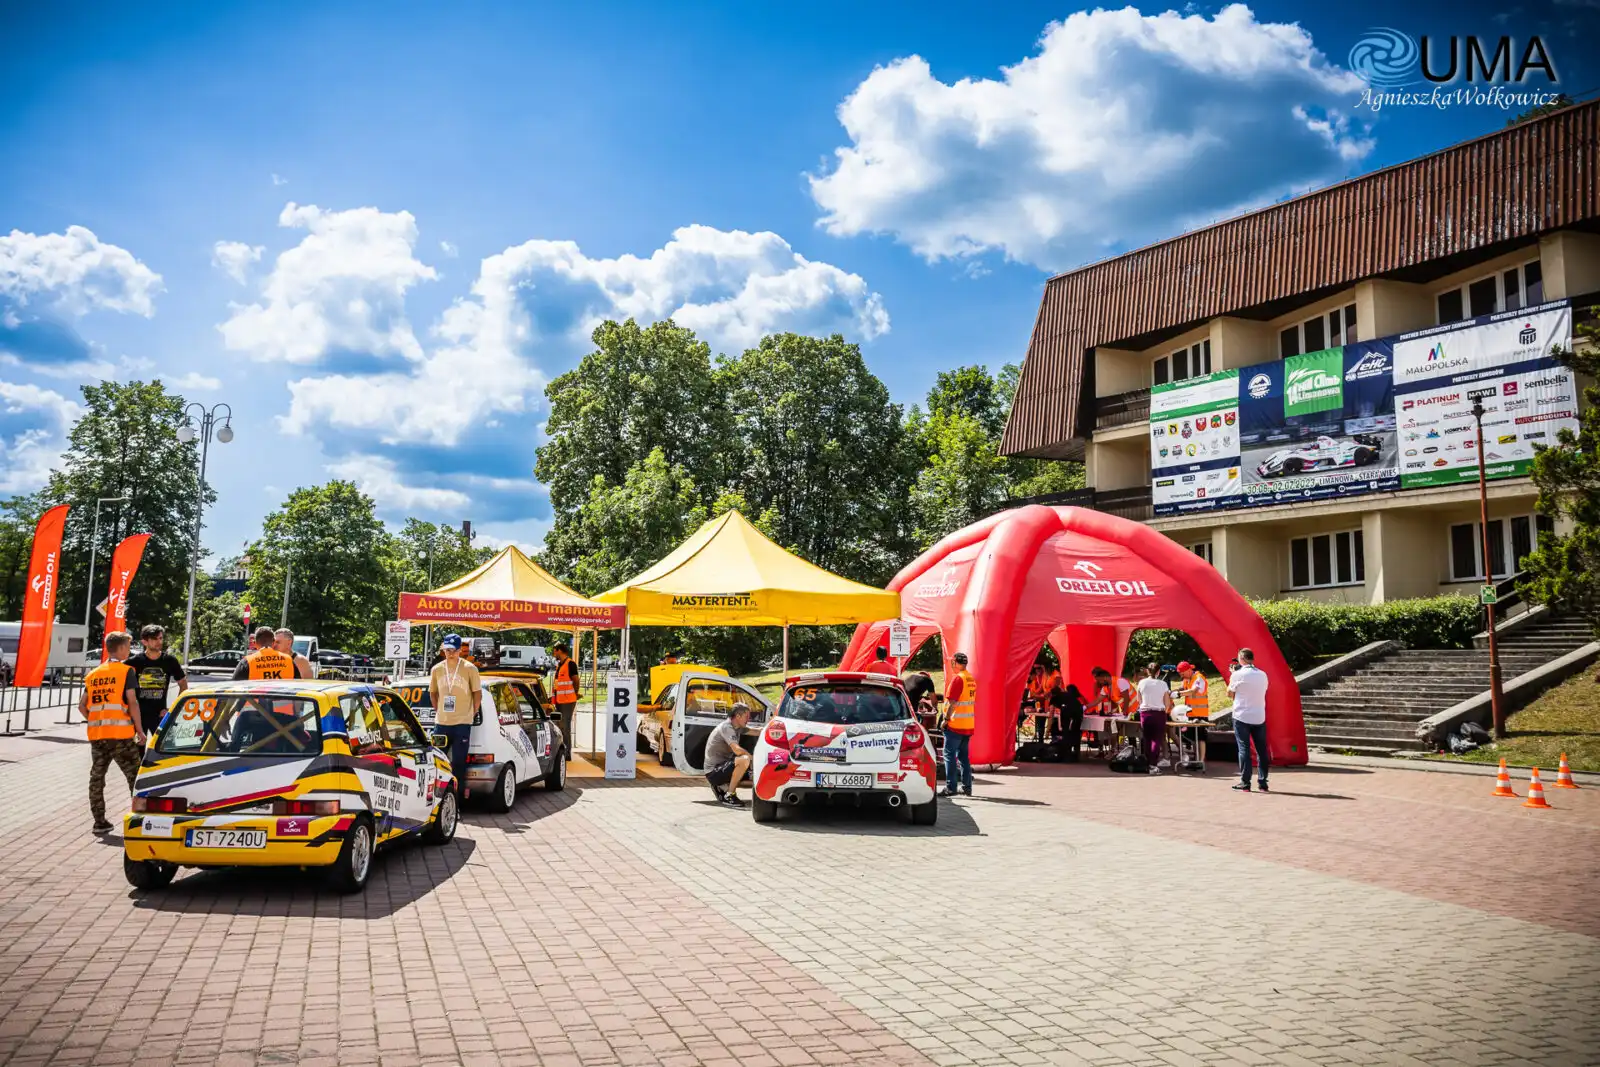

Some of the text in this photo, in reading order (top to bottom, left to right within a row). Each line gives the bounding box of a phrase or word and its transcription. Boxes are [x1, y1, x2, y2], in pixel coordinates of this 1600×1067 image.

[1406, 357, 1468, 376] MAŁOPOLSKA
[1524, 375, 1568, 390] sembella
[1417, 393, 1460, 406] PLATINUM
[47, 552, 56, 574] OIL
[1060, 579, 1155, 596] ORLEN OIL
[417, 597, 613, 617] Auto Moto Klub Limanowa
[672, 595, 751, 607] MASTERTENT
[416, 610, 501, 620] www.automotoklub.com.pl
[394, 644, 401, 655] 2
[897, 643, 902, 652] 1
[263, 670, 282, 680] BK
[794, 688, 818, 701] 65
[183, 698, 218, 722] 98
[850, 738, 899, 749] Pawlimex
[842, 775, 871, 786] 66887
[195, 831, 262, 848] ST 7240U
